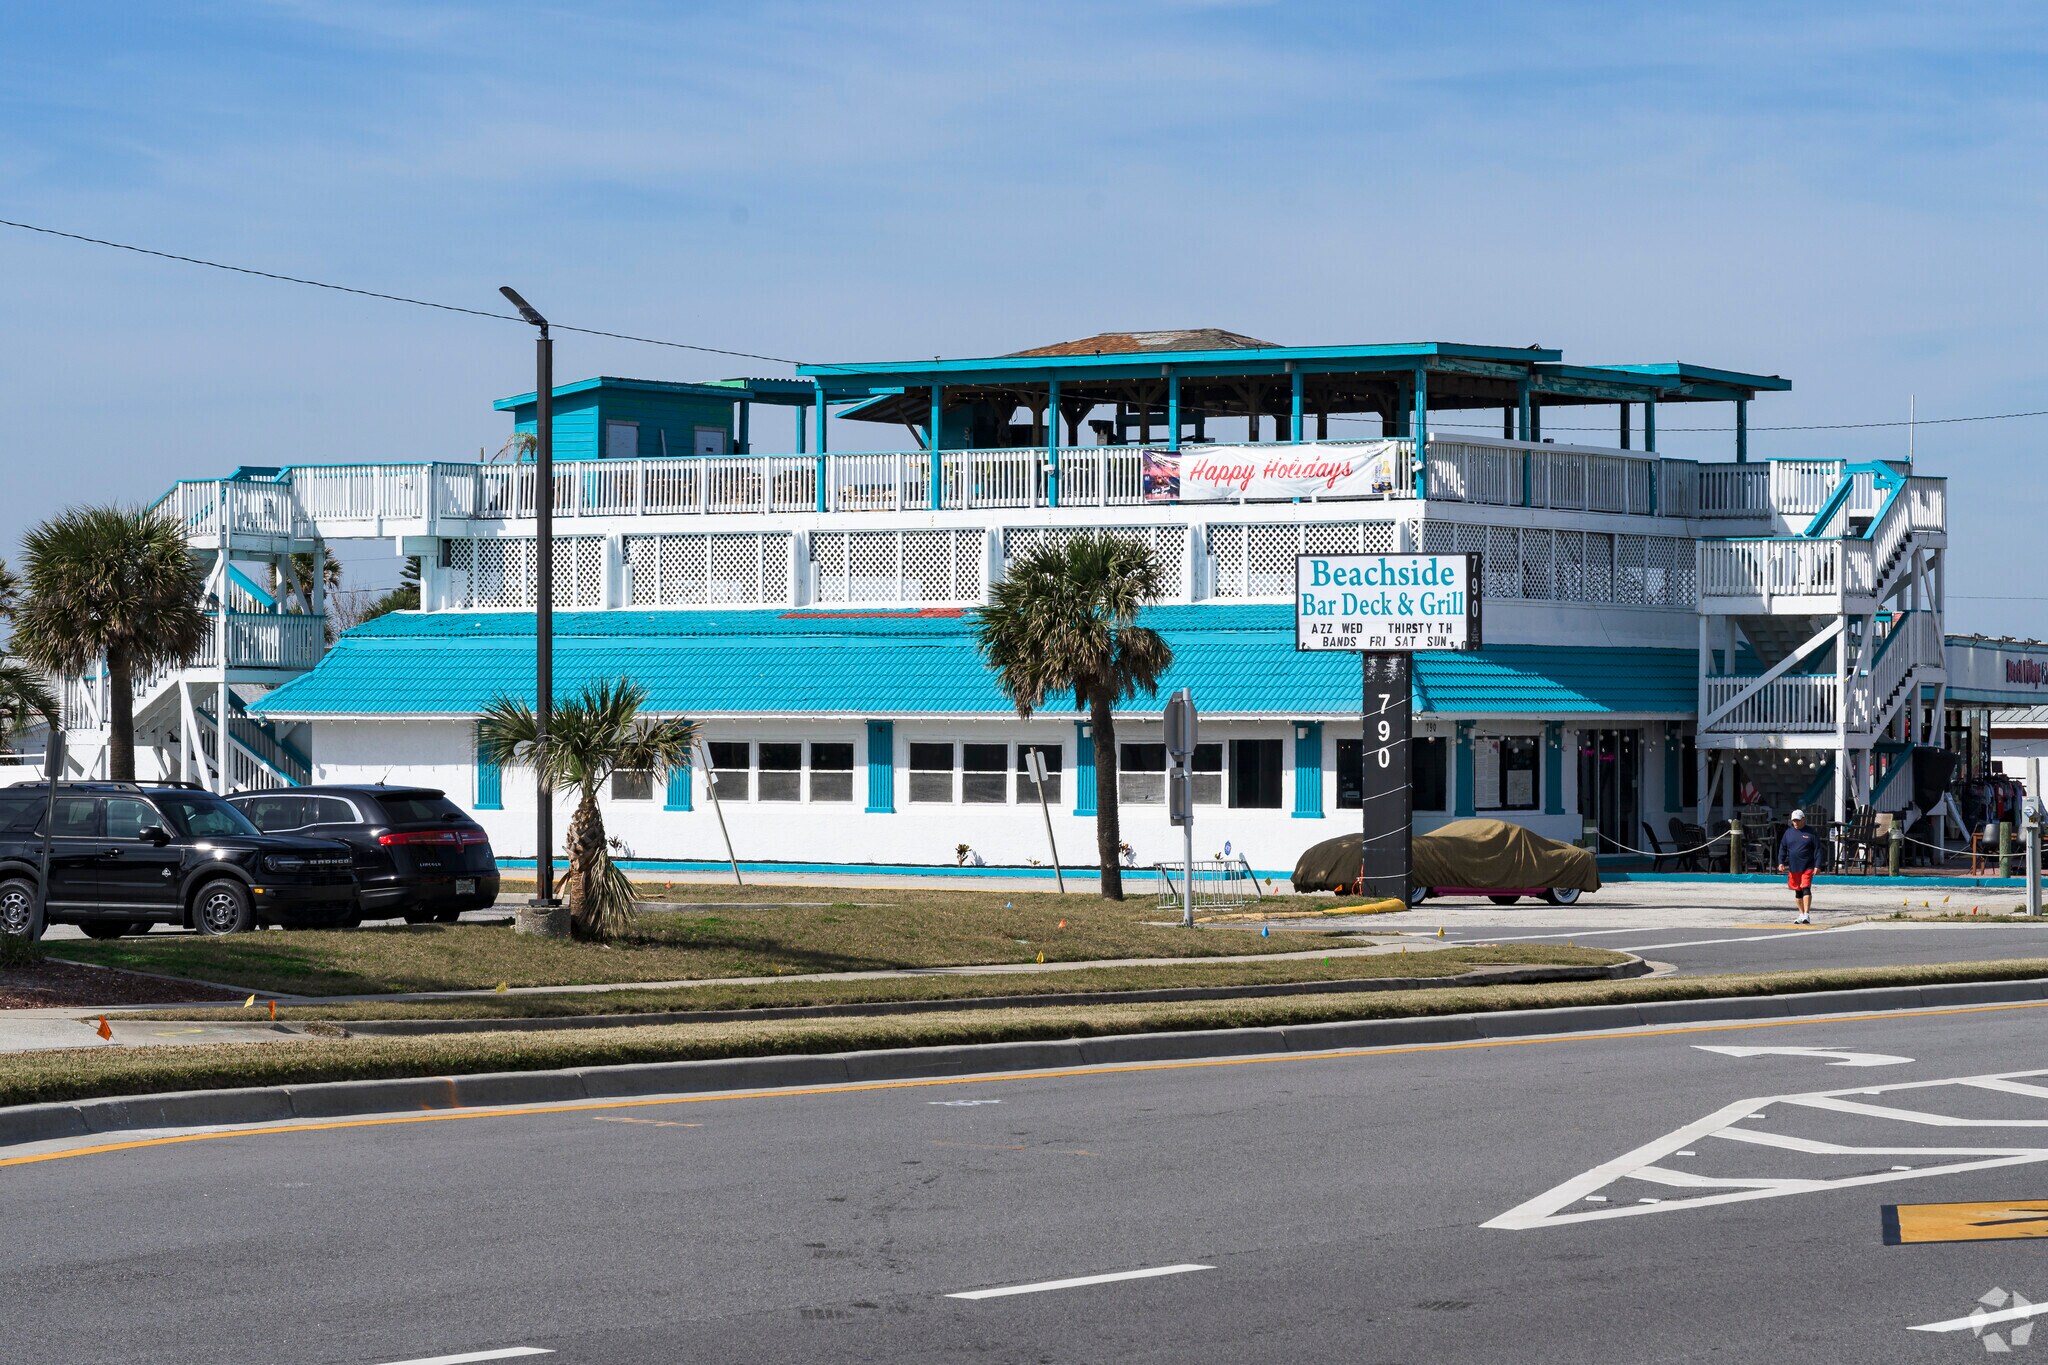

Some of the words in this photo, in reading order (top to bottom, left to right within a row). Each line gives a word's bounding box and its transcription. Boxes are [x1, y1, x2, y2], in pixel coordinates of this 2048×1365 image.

[1189, 458, 1255, 492] Happy
[1263, 455, 1353, 489] Holidays
[1310, 557, 1454, 587] Beachside
[1471, 555, 1479, 618] 790
[1301, 593, 1336, 616] Bar
[1341, 591, 1393, 616] Deck
[1397, 591, 1414, 617] &
[1420, 591, 1464, 616] Grill
[1311, 623, 1333, 634] AZZ
[1342, 623, 1363, 634] WED
[1388, 623, 1432, 634] THIRSTY
[1438, 623, 1453, 634] TH
[1322, 636, 1357, 647] BANDS
[1369, 636, 1386, 647] FRI
[1395, 636, 1416, 647] SAT
[1427, 636, 1447, 647] SUN
[1378, 693, 1391, 768] 790
